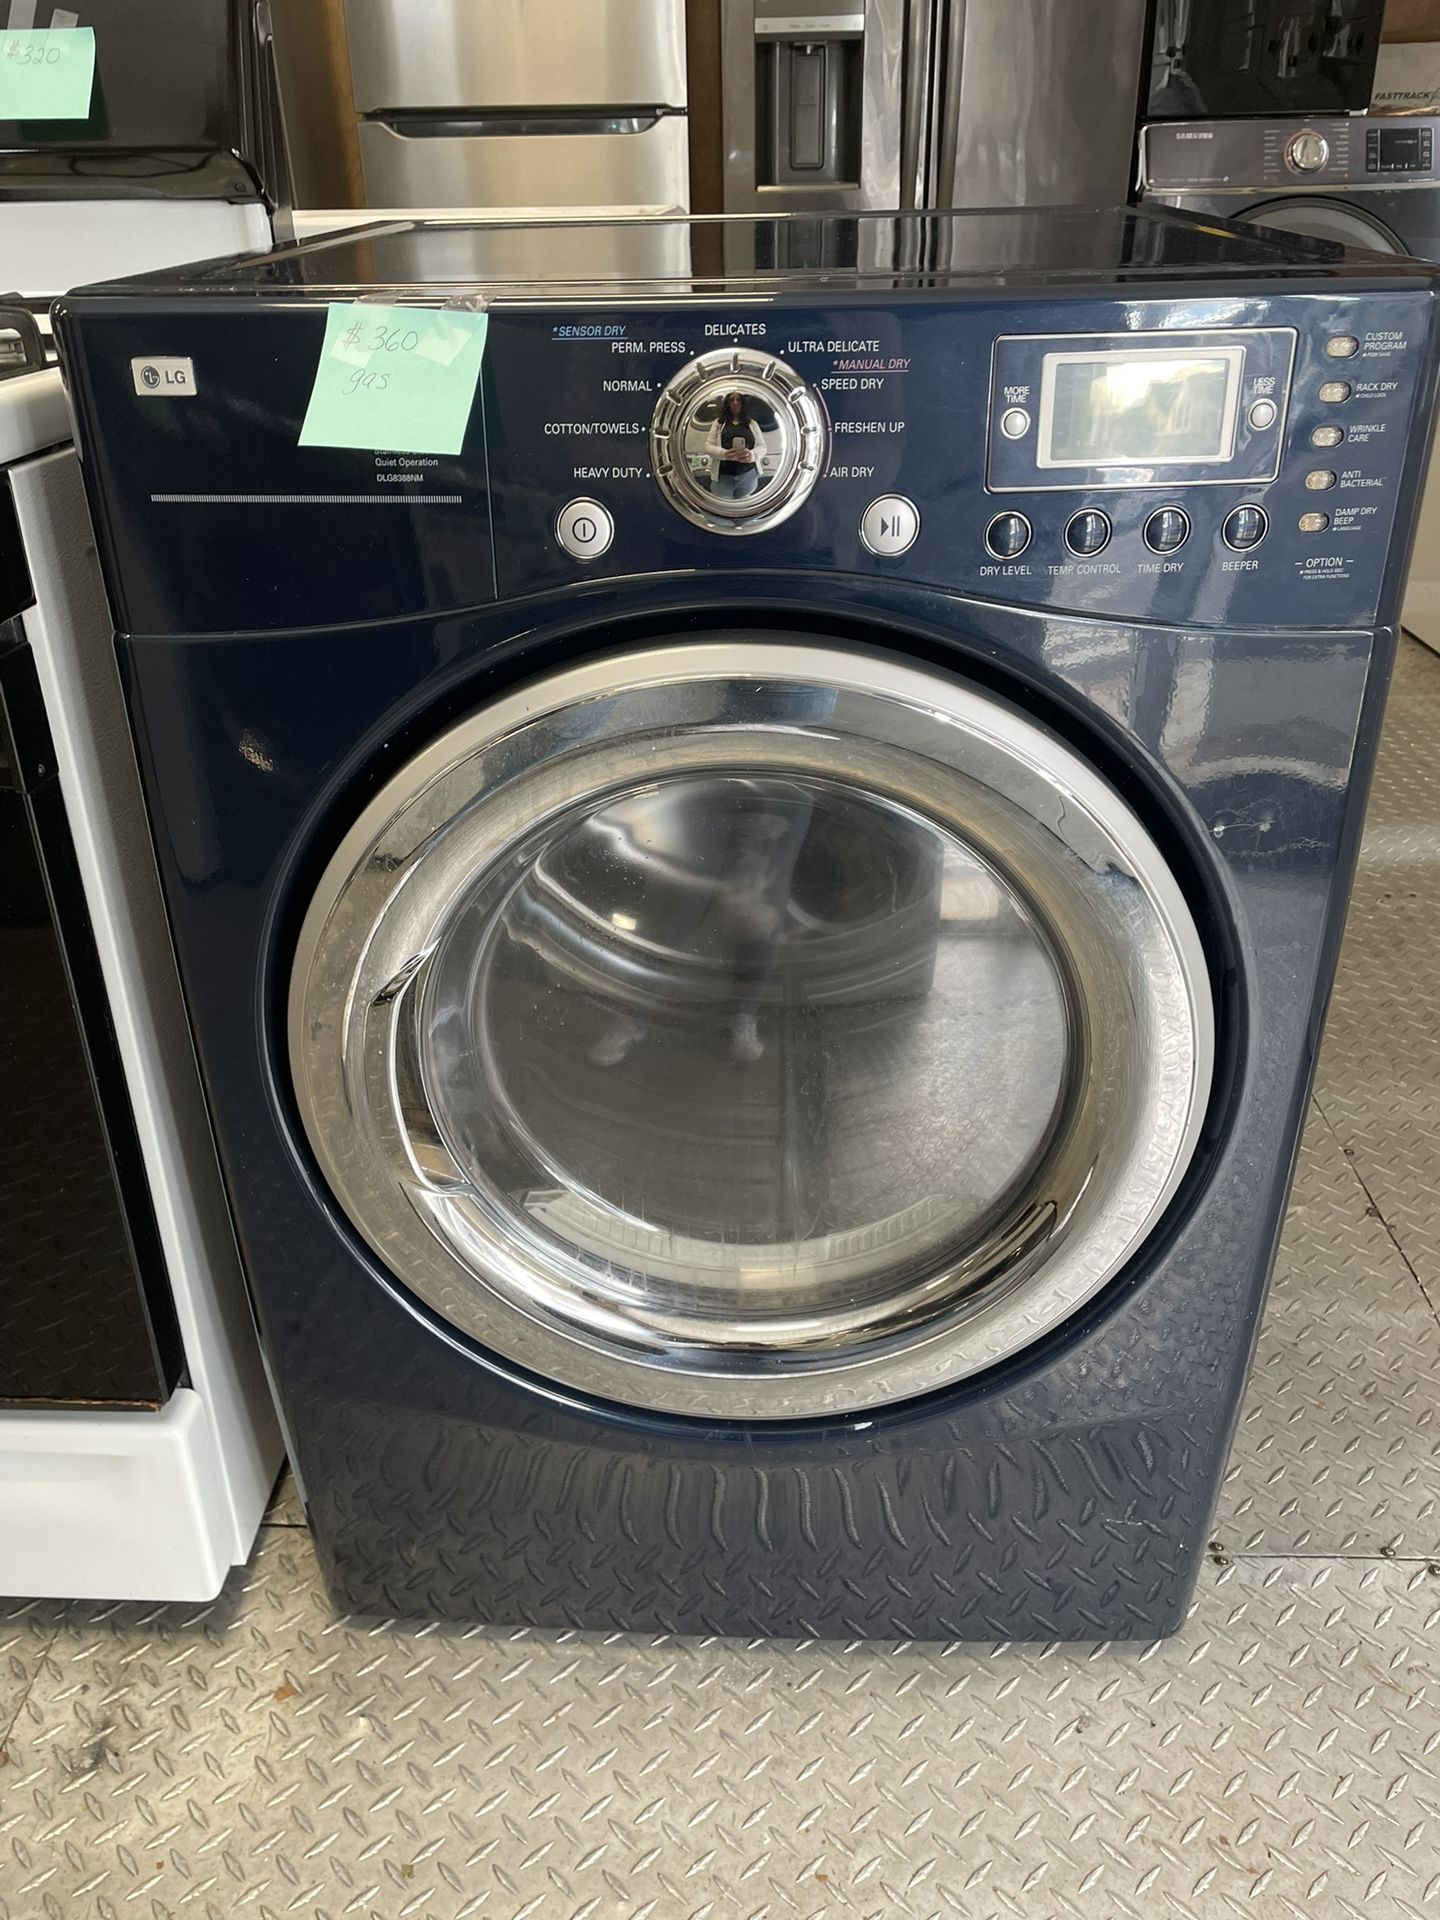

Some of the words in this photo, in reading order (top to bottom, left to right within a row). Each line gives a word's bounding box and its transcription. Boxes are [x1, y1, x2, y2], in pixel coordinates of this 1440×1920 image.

[6, 39, 61, 65] $320
[1374, 92, 1431, 100] FASTTRACK
[604, 326, 626, 336] DRY
[704, 323, 766, 336] DELICATES
[367, 325, 419, 353] 360
[1366, 332, 1403, 340] CUSTOM
[611, 342, 646, 353] PERM.
[649, 342, 686, 353] PRESS
[788, 341, 824, 352] ULTRA
[827, 340, 879, 352] DELICATE
[1364, 342, 1407, 350] PROGRAM
[888, 358, 911, 369] DRY
[166, 370, 186, 385] LG
[342, 368, 391, 395] gas
[1254, 377, 1275, 386] LESS
[603, 380, 652, 391] NORMAL
[821, 379, 857, 390] SPEED
[860, 378, 884, 389] DRY
[1357, 383, 1379, 391] RACK
[1381, 382, 1398, 390] DRY
[1004, 386, 1030, 395] MORE
[1253, 386, 1273, 394] TIME
[1006, 394, 1026, 403] TIME
[544, 423, 639, 435] COTTON/TOWELS
[834, 422, 886, 433] FRESHEN
[889, 422, 905, 433] UP
[1350, 424, 1386, 433] WRINKLE
[1348, 434, 1370, 442] CARE
[375, 458, 397, 466] Quiet
[398, 457, 438, 467] Operation
[573, 467, 610, 478] HEAVY
[612, 467, 642, 478] DUTY
[829, 467, 848, 477] AIR
[851, 466, 875, 477] DRY
[1342, 471, 1361, 479] ANTI
[1340, 479, 1383, 488] BACTERIAL
[1335, 508, 1360, 516] DAMP
[1360, 507, 1377, 515] DRY
[1334, 517, 1354, 525] BEEP
[1222, 561, 1259, 571] BEEPER
[1306, 557, 1343, 567] OPTION
[980, 566, 1001, 576] DRY
[1003, 565, 1032, 575] LEVEL
[1048, 566, 1074, 575] TEMP.
[1076, 564, 1121, 574] CONTROL
[1137, 564, 1161, 573] TIME
[1163, 563, 1184, 572] DRY
